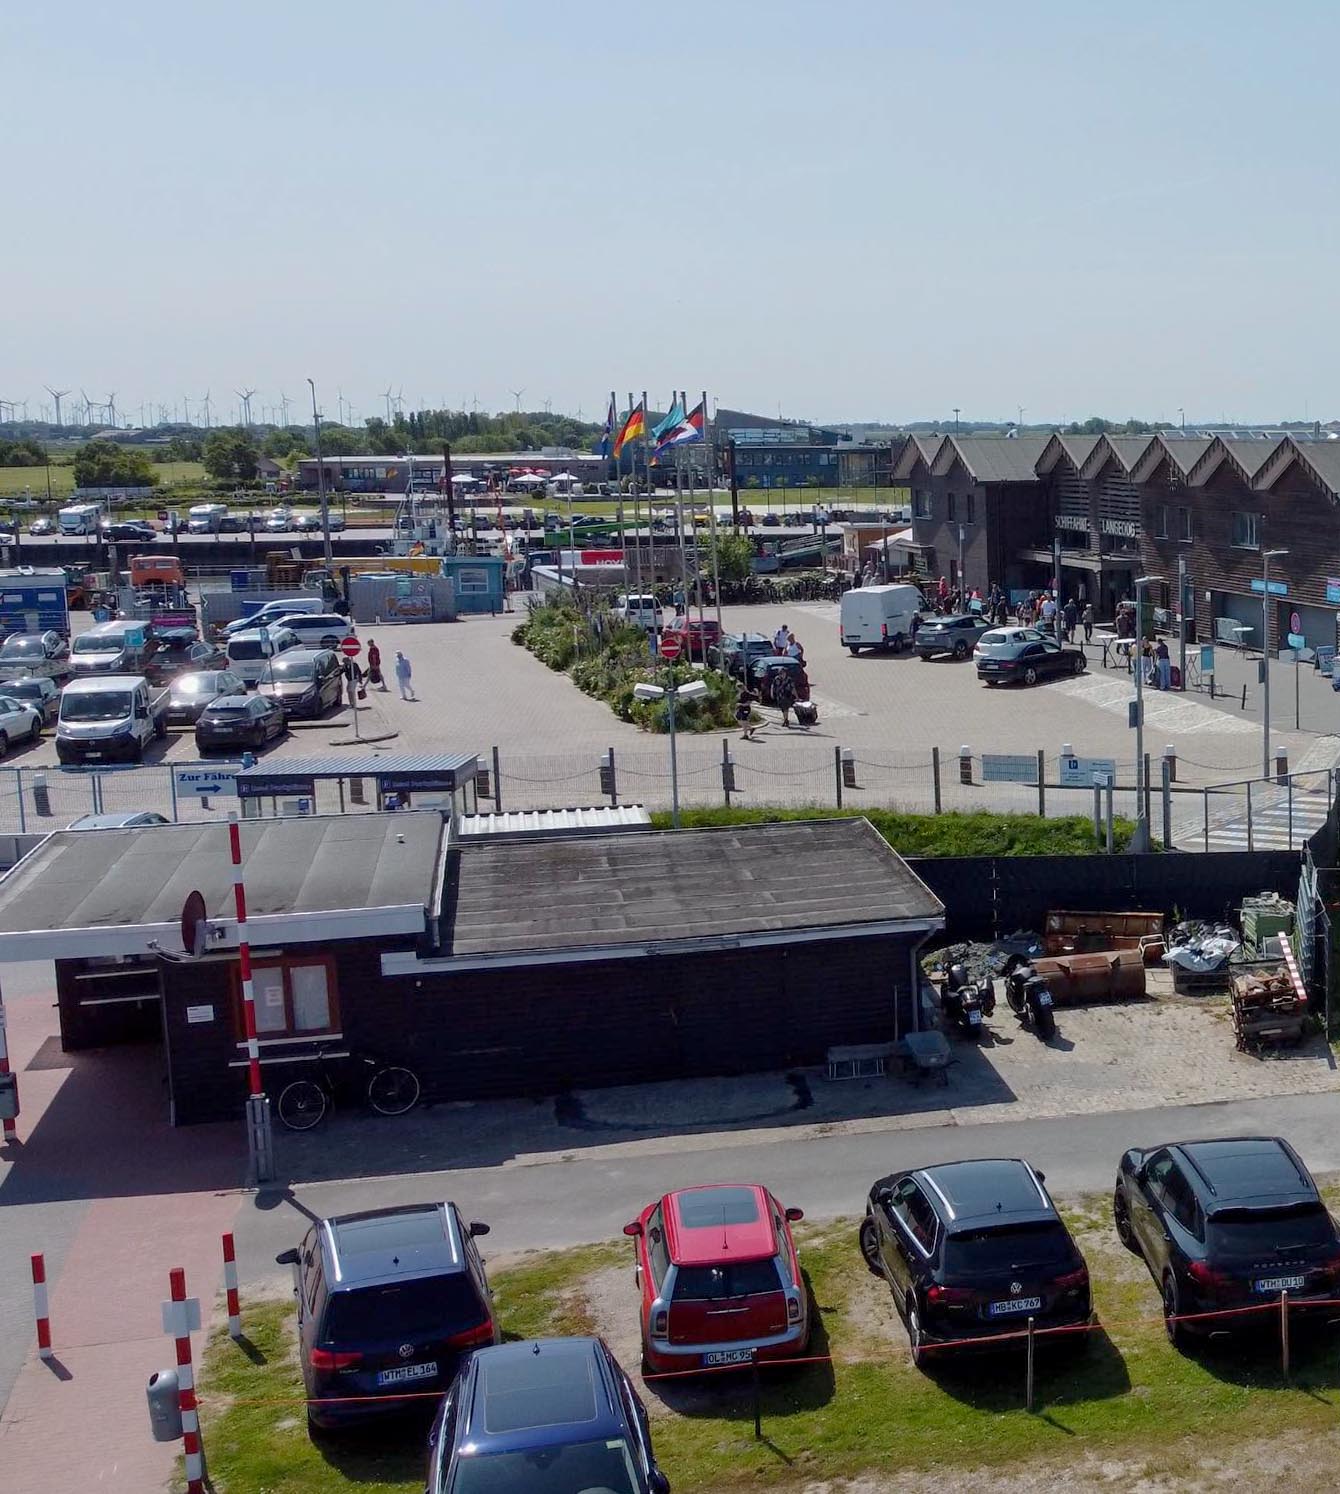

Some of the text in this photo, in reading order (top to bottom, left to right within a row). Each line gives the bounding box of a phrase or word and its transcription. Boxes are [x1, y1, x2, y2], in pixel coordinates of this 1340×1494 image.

[1102, 519, 1136, 537] LANGEOOG
[179, 773, 201, 782] Zur
[384, 1362, 437, 1381] WTM EL 164
